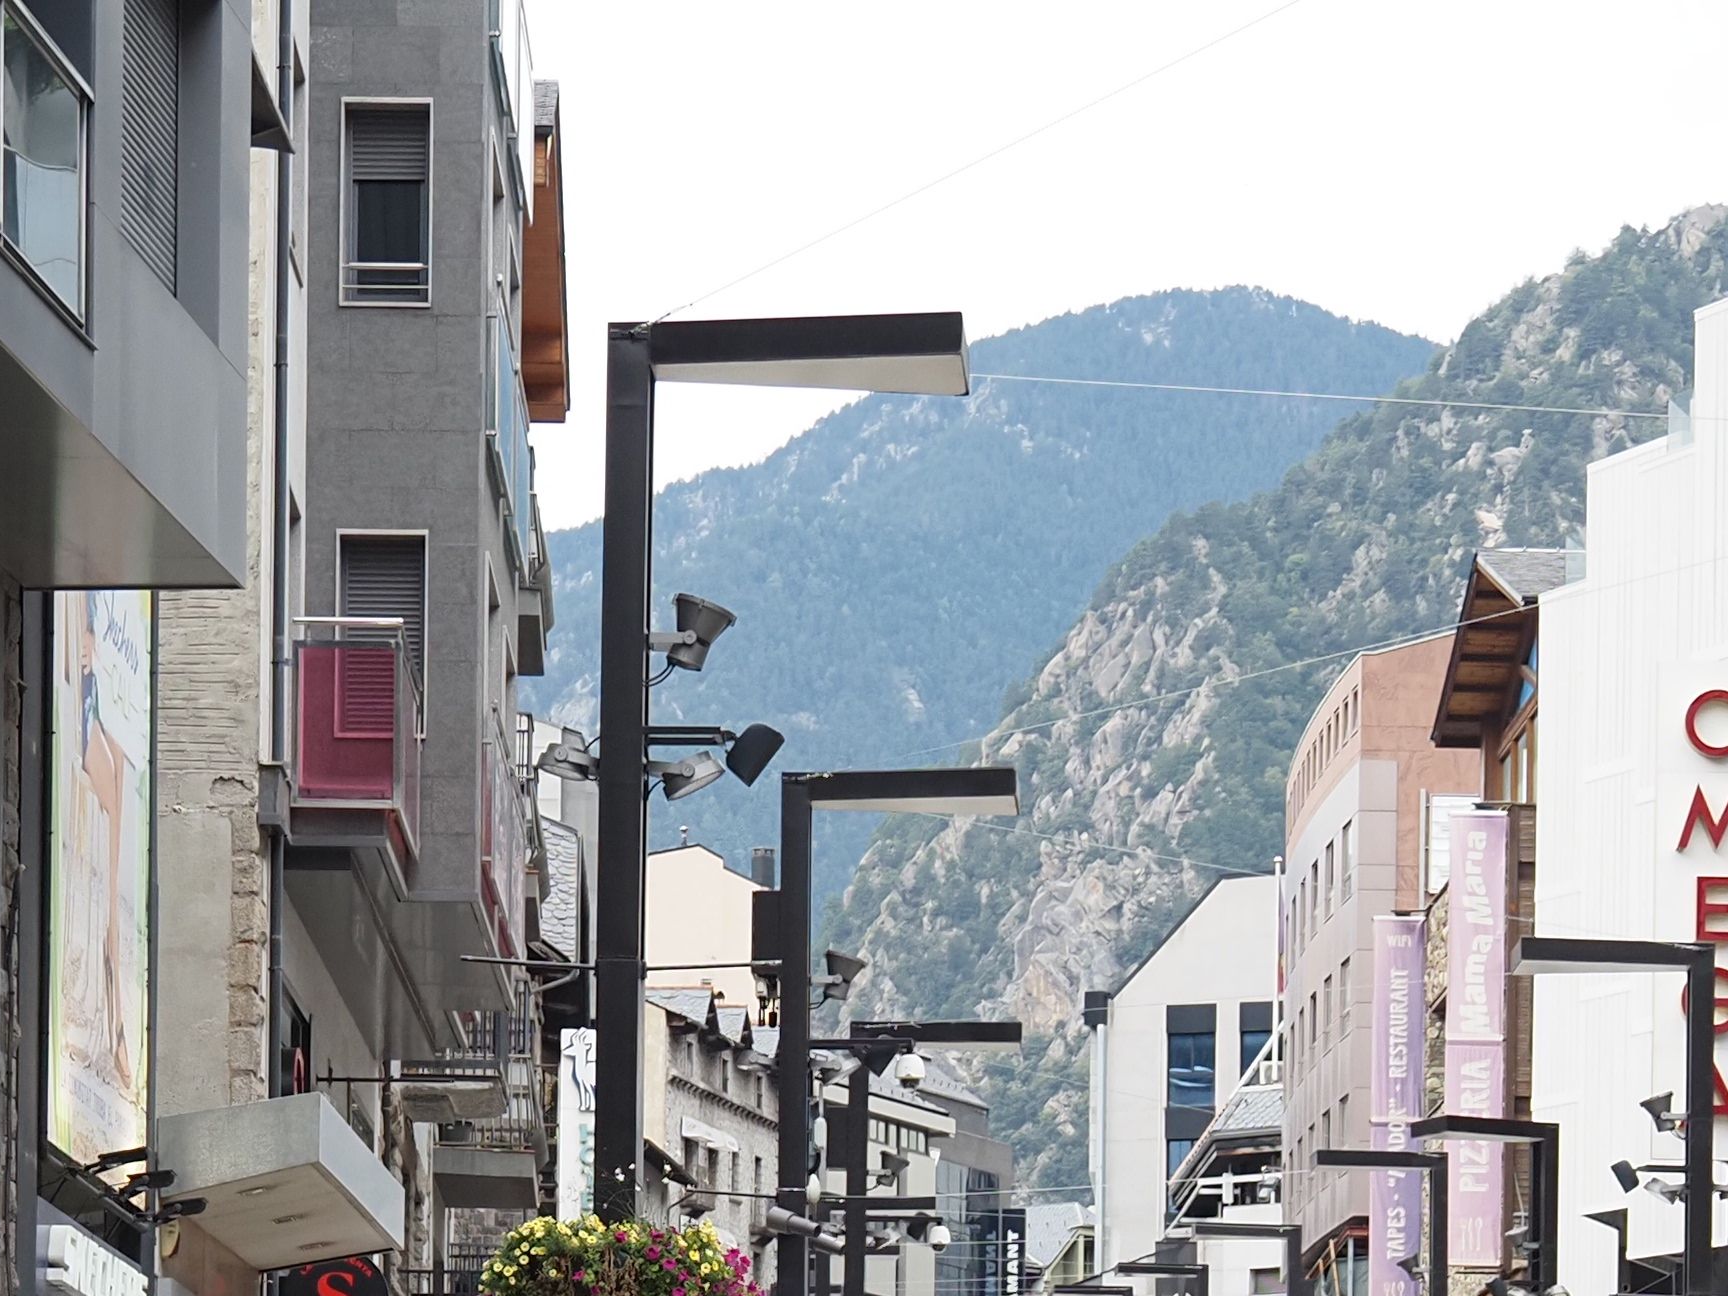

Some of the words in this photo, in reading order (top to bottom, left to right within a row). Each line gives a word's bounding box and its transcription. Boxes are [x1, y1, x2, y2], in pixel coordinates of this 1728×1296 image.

[1462, 831, 1494, 926] Maria
[1388, 967, 1409, 1079] RESTAURANT
[1460, 934, 1494, 1034] Mama
[1386, 1206, 1406, 1260] TAPES
